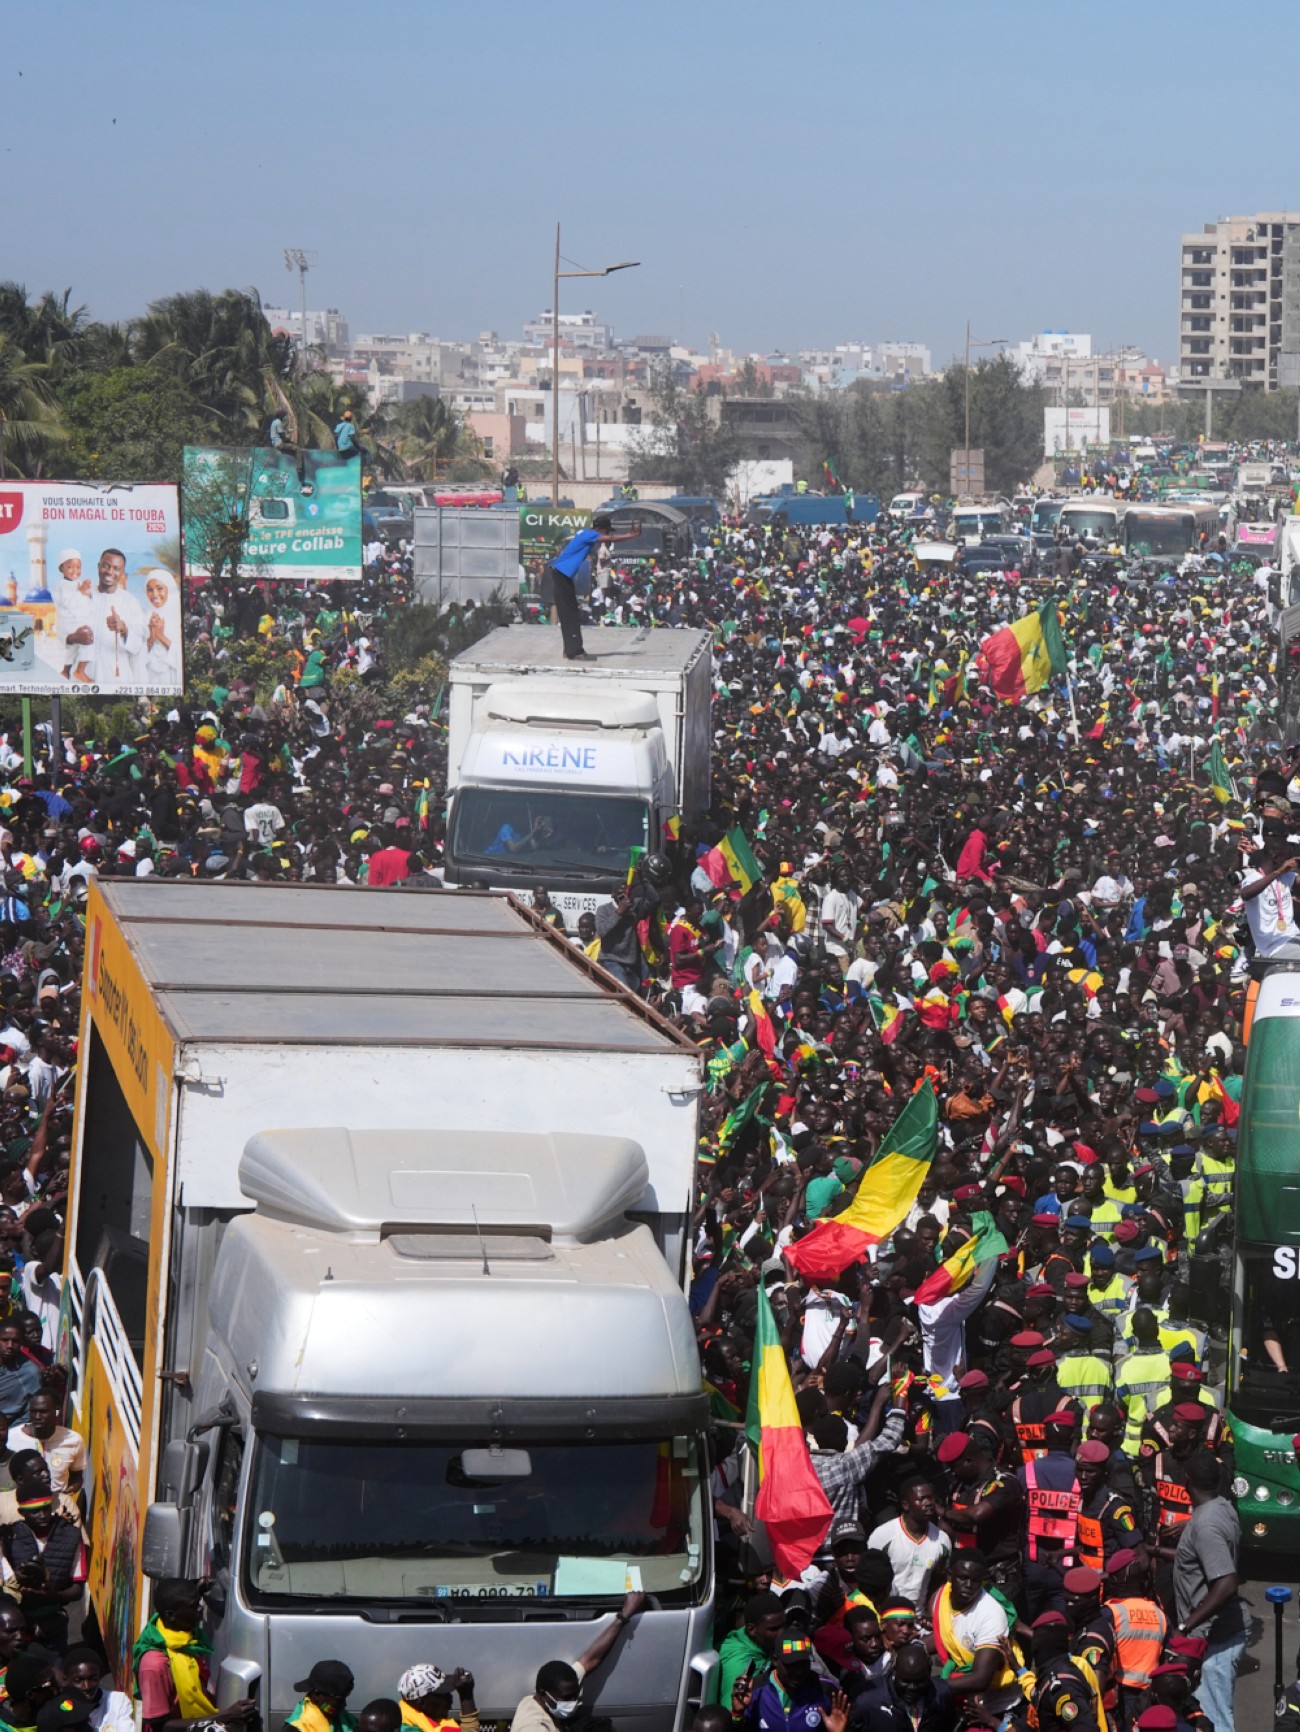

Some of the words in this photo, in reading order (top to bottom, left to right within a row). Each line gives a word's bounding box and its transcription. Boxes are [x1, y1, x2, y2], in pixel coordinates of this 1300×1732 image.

[42, 497, 65, 507] VOUS
[66, 497, 104, 507] SOUHAITE
[106, 497, 118, 507] UN
[42, 508, 65, 520] BON
[69, 508, 108, 521] MAGAL
[111, 509, 126, 521] DE
[128, 509, 166, 522] TOUBA
[525, 513, 543, 526] CI
[548, 514, 588, 528] KAW
[147, 523, 165, 532] 2025
[274, 529, 294, 539] TPE
[295, 525, 344, 537] encaisse
[241, 541, 287, 556] leure
[291, 535, 345, 552] Collab
[134, 687, 144, 695] 33
[145, 687, 160, 695] 864
[1018, 1427, 1047, 1440] POLI
[1263, 1449, 1298, 1465] HIG
[1159, 1483, 1190, 1502] POLIC
[1031, 1492, 1079, 1509] POLICE
[1128, 1608, 1160, 1623] POLICE
